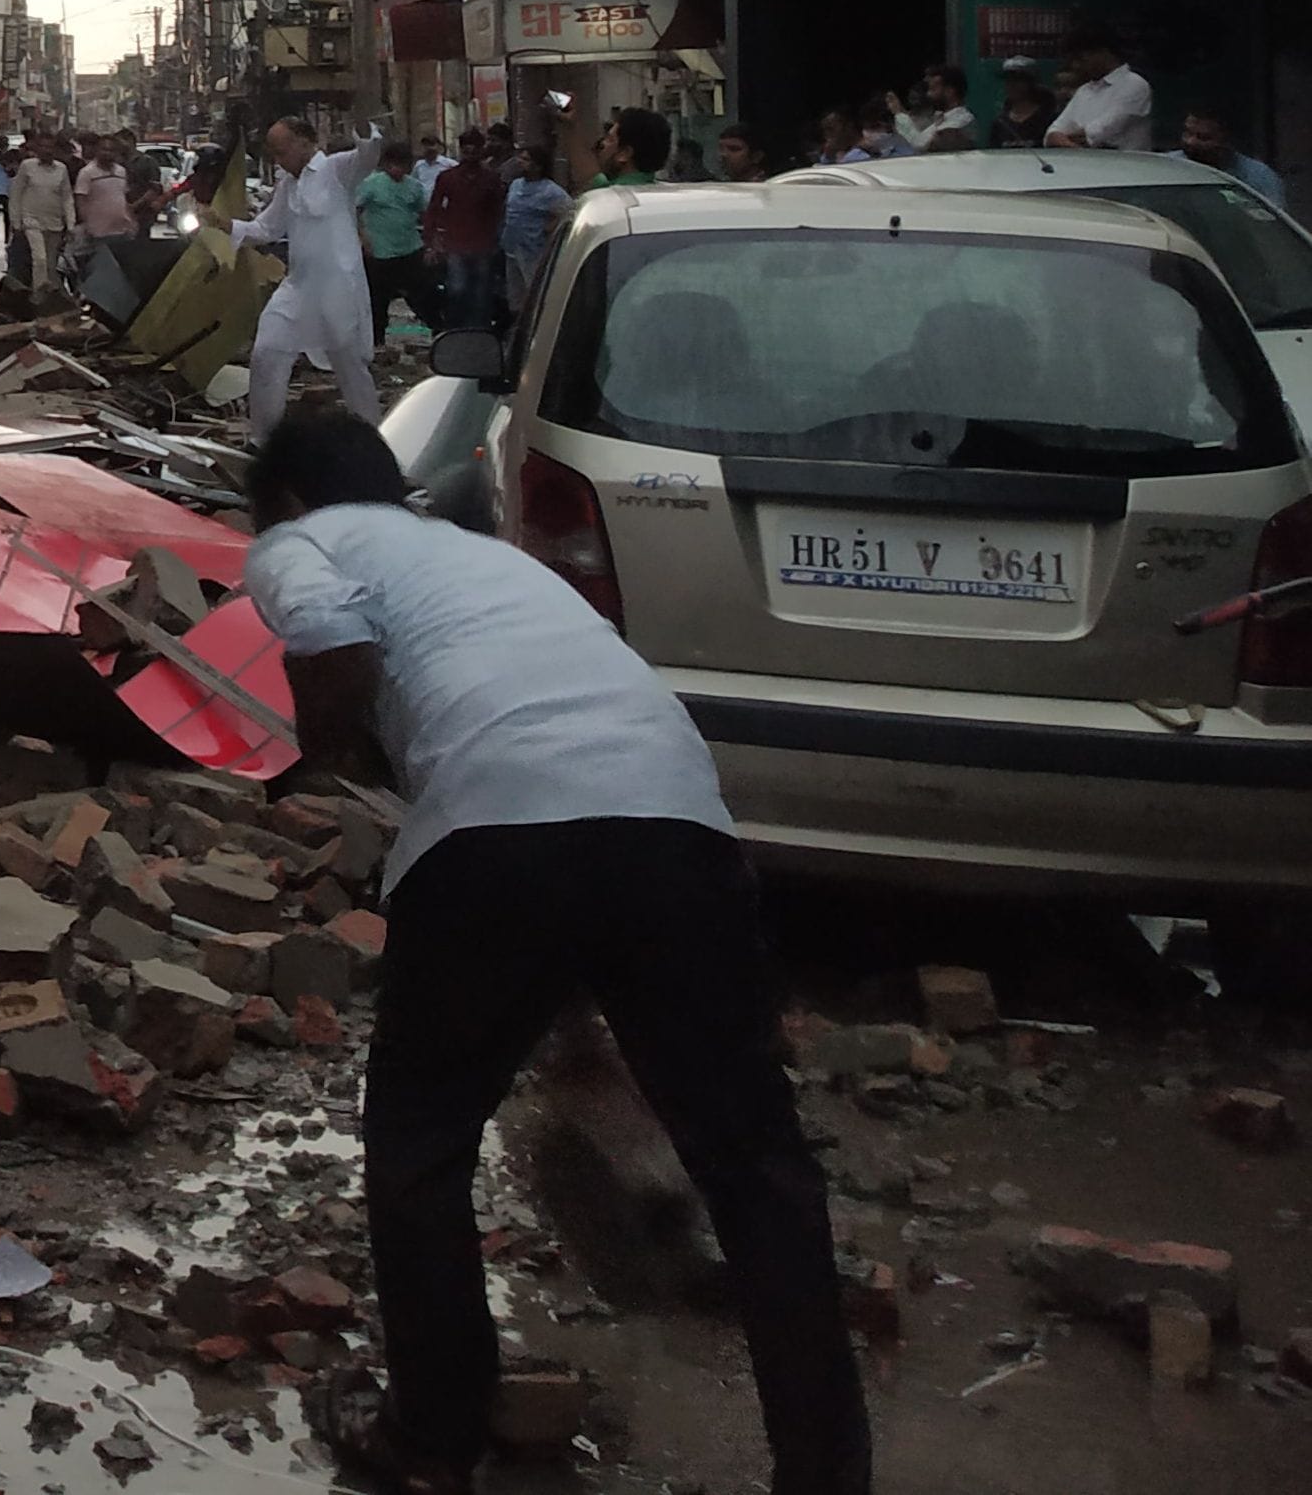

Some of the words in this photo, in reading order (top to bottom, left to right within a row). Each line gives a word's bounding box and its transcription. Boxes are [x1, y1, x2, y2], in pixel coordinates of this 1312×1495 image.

[520, 1, 572, 38] SF
[586, 5, 637, 22] FAST
[584, 21, 644, 39] FOOD
[915, 540, 942, 577] V
